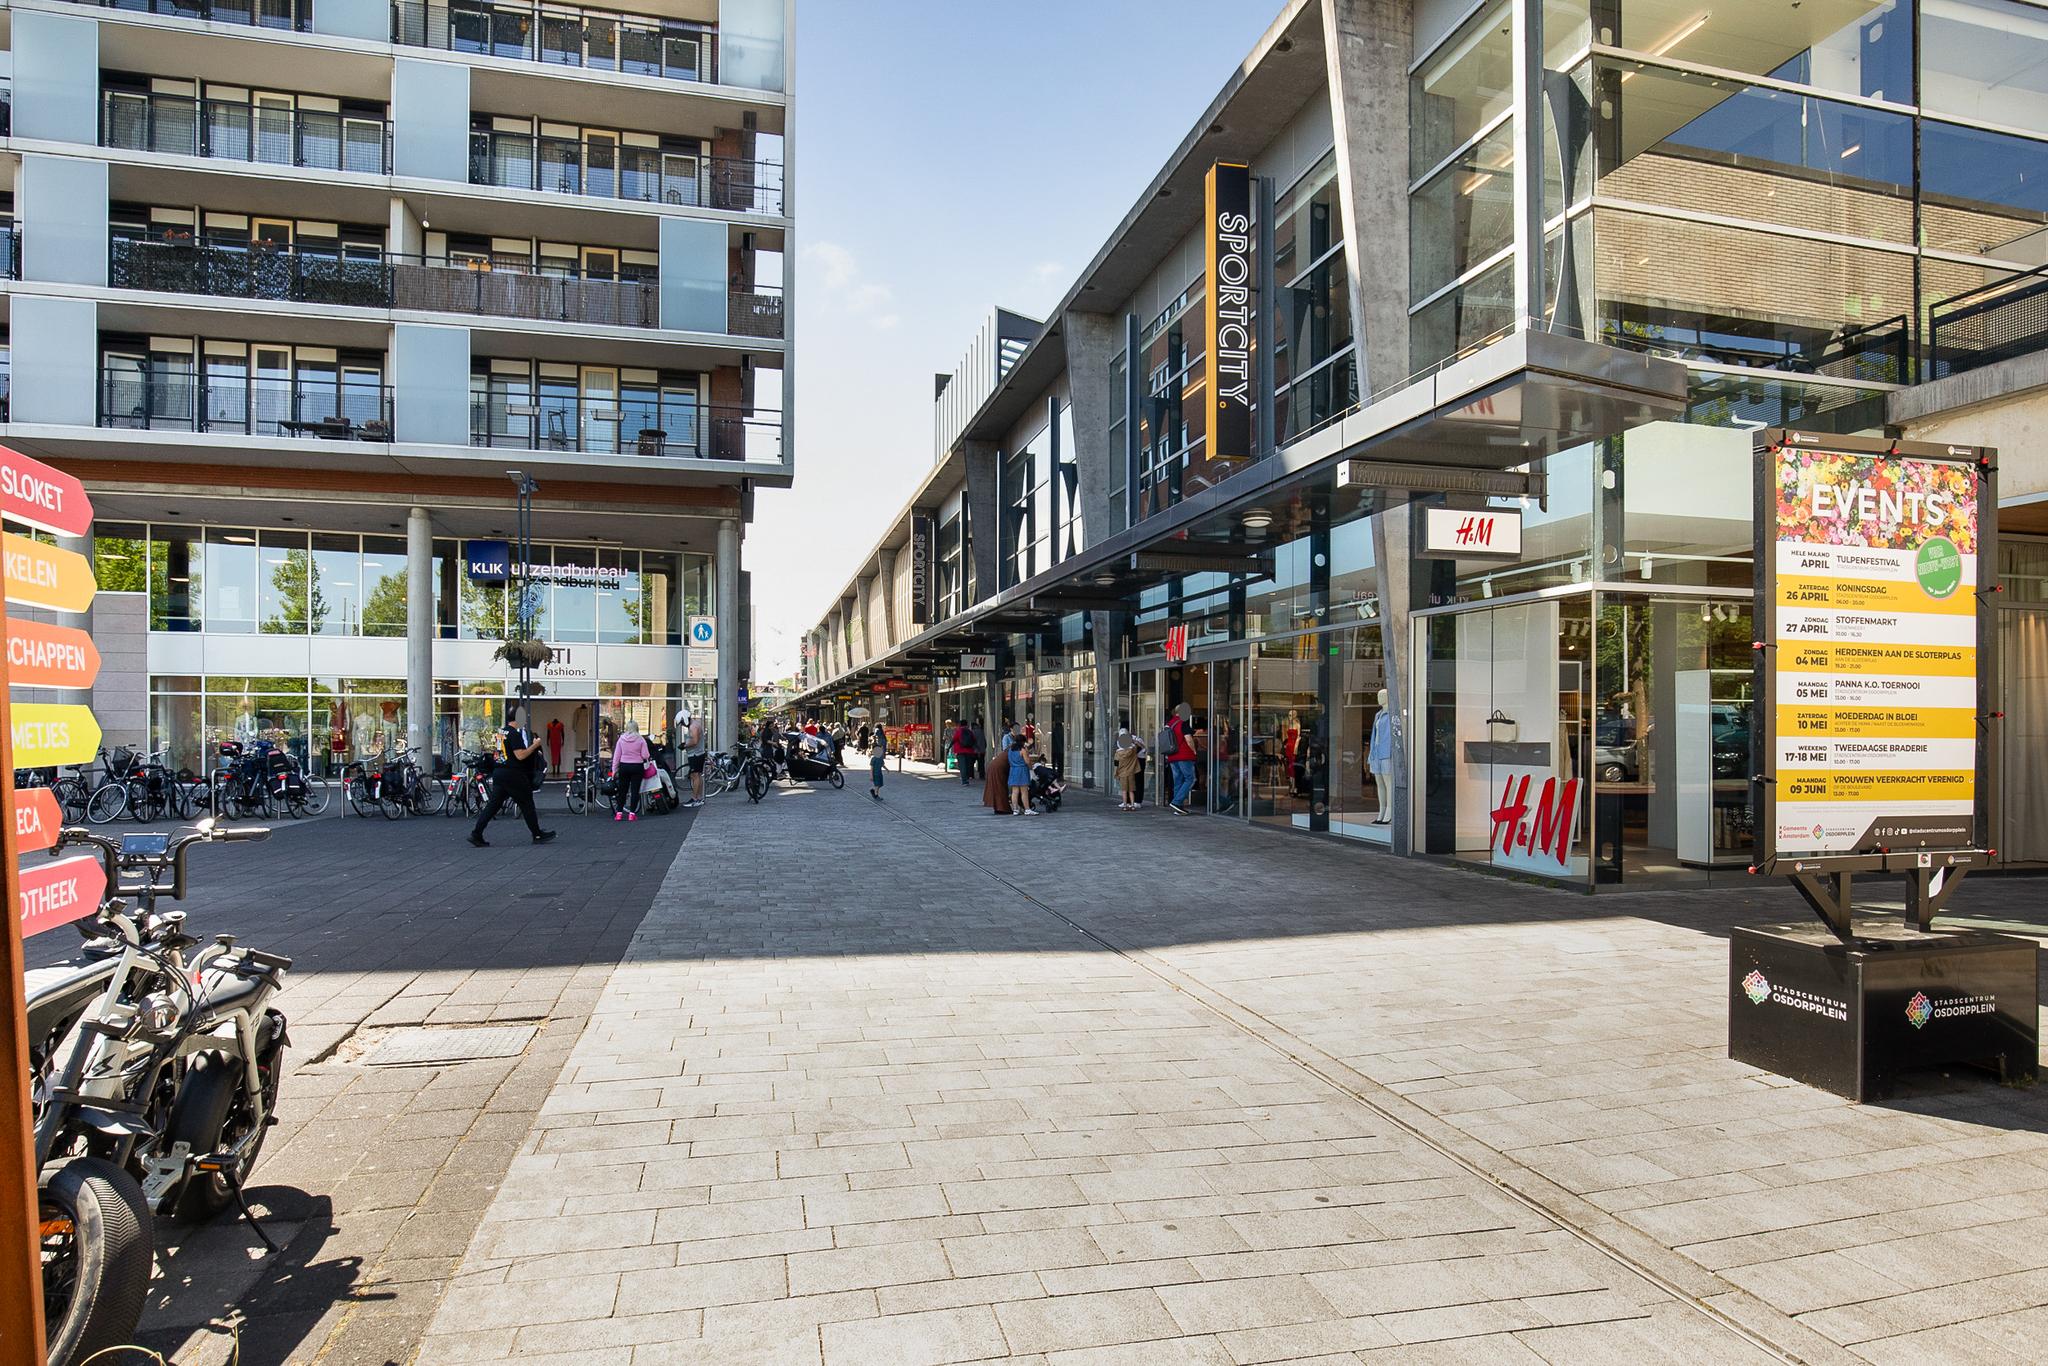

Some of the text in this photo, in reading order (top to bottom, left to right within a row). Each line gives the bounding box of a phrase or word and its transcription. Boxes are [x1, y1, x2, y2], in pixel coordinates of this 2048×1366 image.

[0, 465, 64, 513] SLOKET
[1811, 481, 1947, 526] EVENTS
[1456, 516, 1494, 546] H&M
[1801, 559, 1830, 569] APRIL
[1836, 555, 1901, 567] TULPENFESTIVAL
[3, 550, 58, 588] KELEN
[472, 562, 503, 574] KLIK
[1836, 583, 1887, 594] KONINGSDAG
[1786, 591, 1830, 602] 26 APRIL
[1835, 616, 1897, 626] STOFFENMARKT
[1786, 623, 1798, 633] 27
[1799, 624, 1829, 634] APRIL
[1835, 648, 1962, 660] HERDENKEN AAN DE SLOTERPLAS
[1795, 656, 1828, 666] 04 MEI
[544, 666, 586, 676] fashions
[1835, 680, 1921, 690] PANNA K.O. TOERNOOI
[1796, 689, 1828, 698] 05 MEI
[1834, 712, 1918, 721] MOEDERDAG IN BLOEI
[1797, 720, 1828, 730] 10 MEI
[1834, 743, 1928, 752] TWEEDAAGSE BRADERIE
[1785, 752, 1827, 762] 17-18 MEI
[1833, 775, 1965, 784] VROUWEN VEERKRACHT VERENIGD
[1790, 785, 1827, 794] 09 JUNI
[16, 806, 42, 835] ECA
[1490, 773, 1581, 866] H&M
[1773, 984, 1848, 1010] STADSCENTRUM
[1934, 995, 1996, 1007] STADSCENTRUM
[1773, 992, 1848, 1022] OSDORPPLEIN
[1934, 1003, 1996, 1018] OSDORPPLEIN
